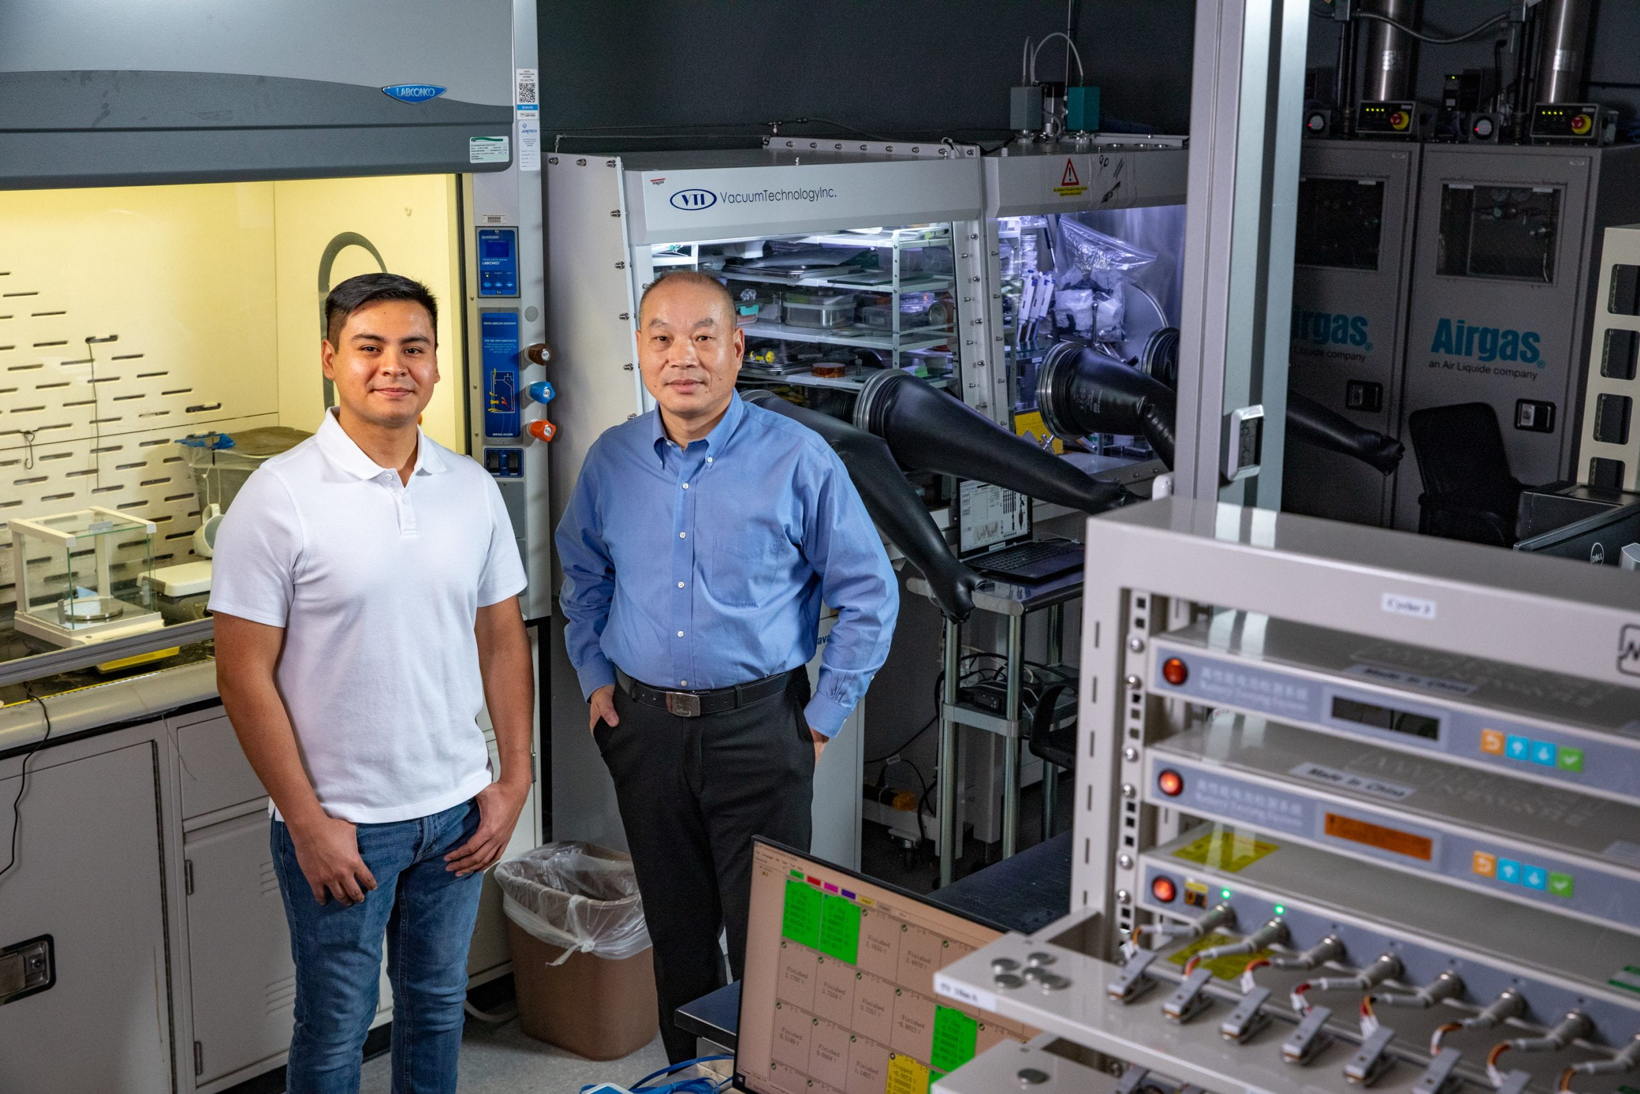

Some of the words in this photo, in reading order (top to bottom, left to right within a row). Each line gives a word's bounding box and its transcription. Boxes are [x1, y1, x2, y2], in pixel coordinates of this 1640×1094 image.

[396, 88, 436, 97] LABCONCO
[682, 194, 705, 206] VTI
[720, 186, 837, 204] VacuumTechnologyInc.
[1292, 310, 1368, 346] irgas
[1430, 318, 1540, 364] Airgas
[1327, 352, 1366, 363] company
[1428, 360, 1440, 368] an
[1442, 360, 1455, 370] Air
[1457, 362, 1491, 375] Liquide
[1493, 368, 1538, 381] company
[1308, 768, 1342, 782] Made
[1366, 780, 1406, 798] China
[867, 934, 890, 948] Finished
[907, 950, 930, 964] Finished
[786, 965, 808, 979] Finished
[823, 981, 845, 996] Finished
[862, 997, 884, 1012] Finished
[901, 1014, 924, 1029] Finished
[781, 1026, 802, 1041] Finished
[818, 1043, 839, 1058] Finished
[856, 1060, 878, 1075] Finished
